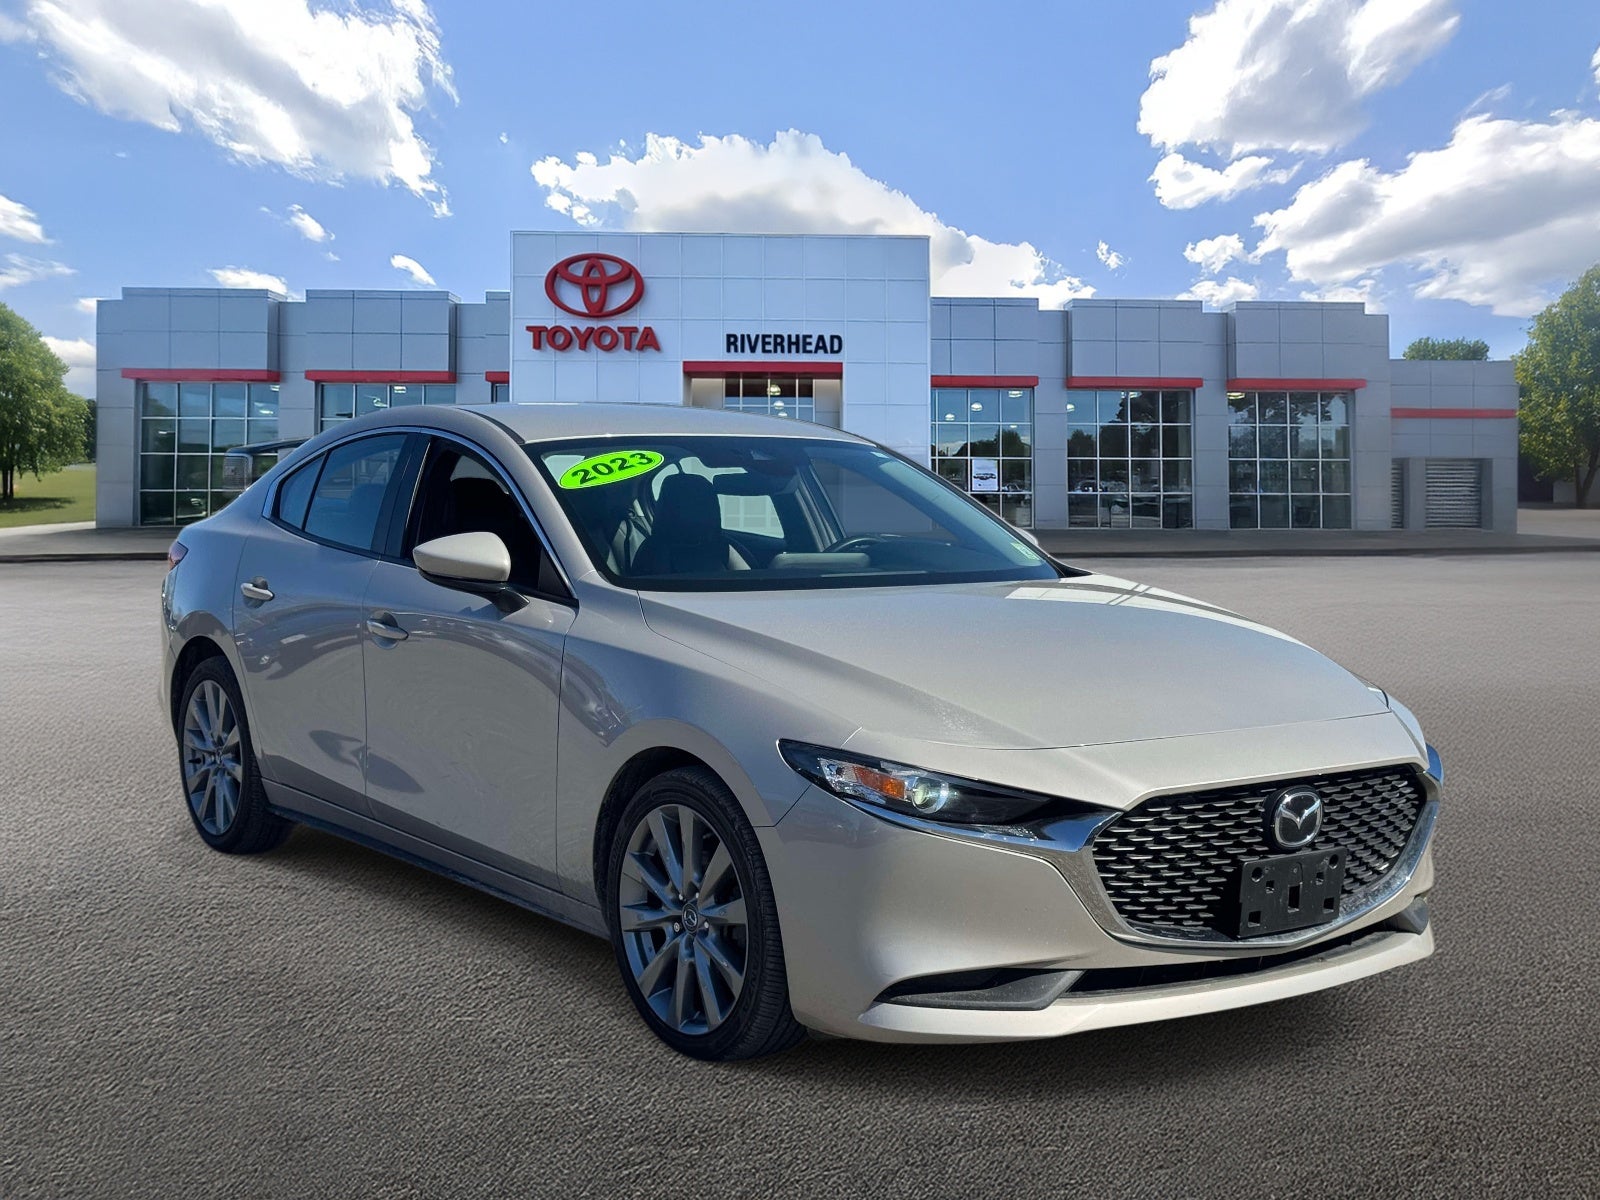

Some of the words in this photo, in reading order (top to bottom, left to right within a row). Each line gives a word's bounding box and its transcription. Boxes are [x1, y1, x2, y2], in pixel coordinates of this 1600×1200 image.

[526, 325, 661, 352] TOYOTA
[726, 333, 843, 354] RIVERHEAD
[571, 453, 654, 485] 2023
